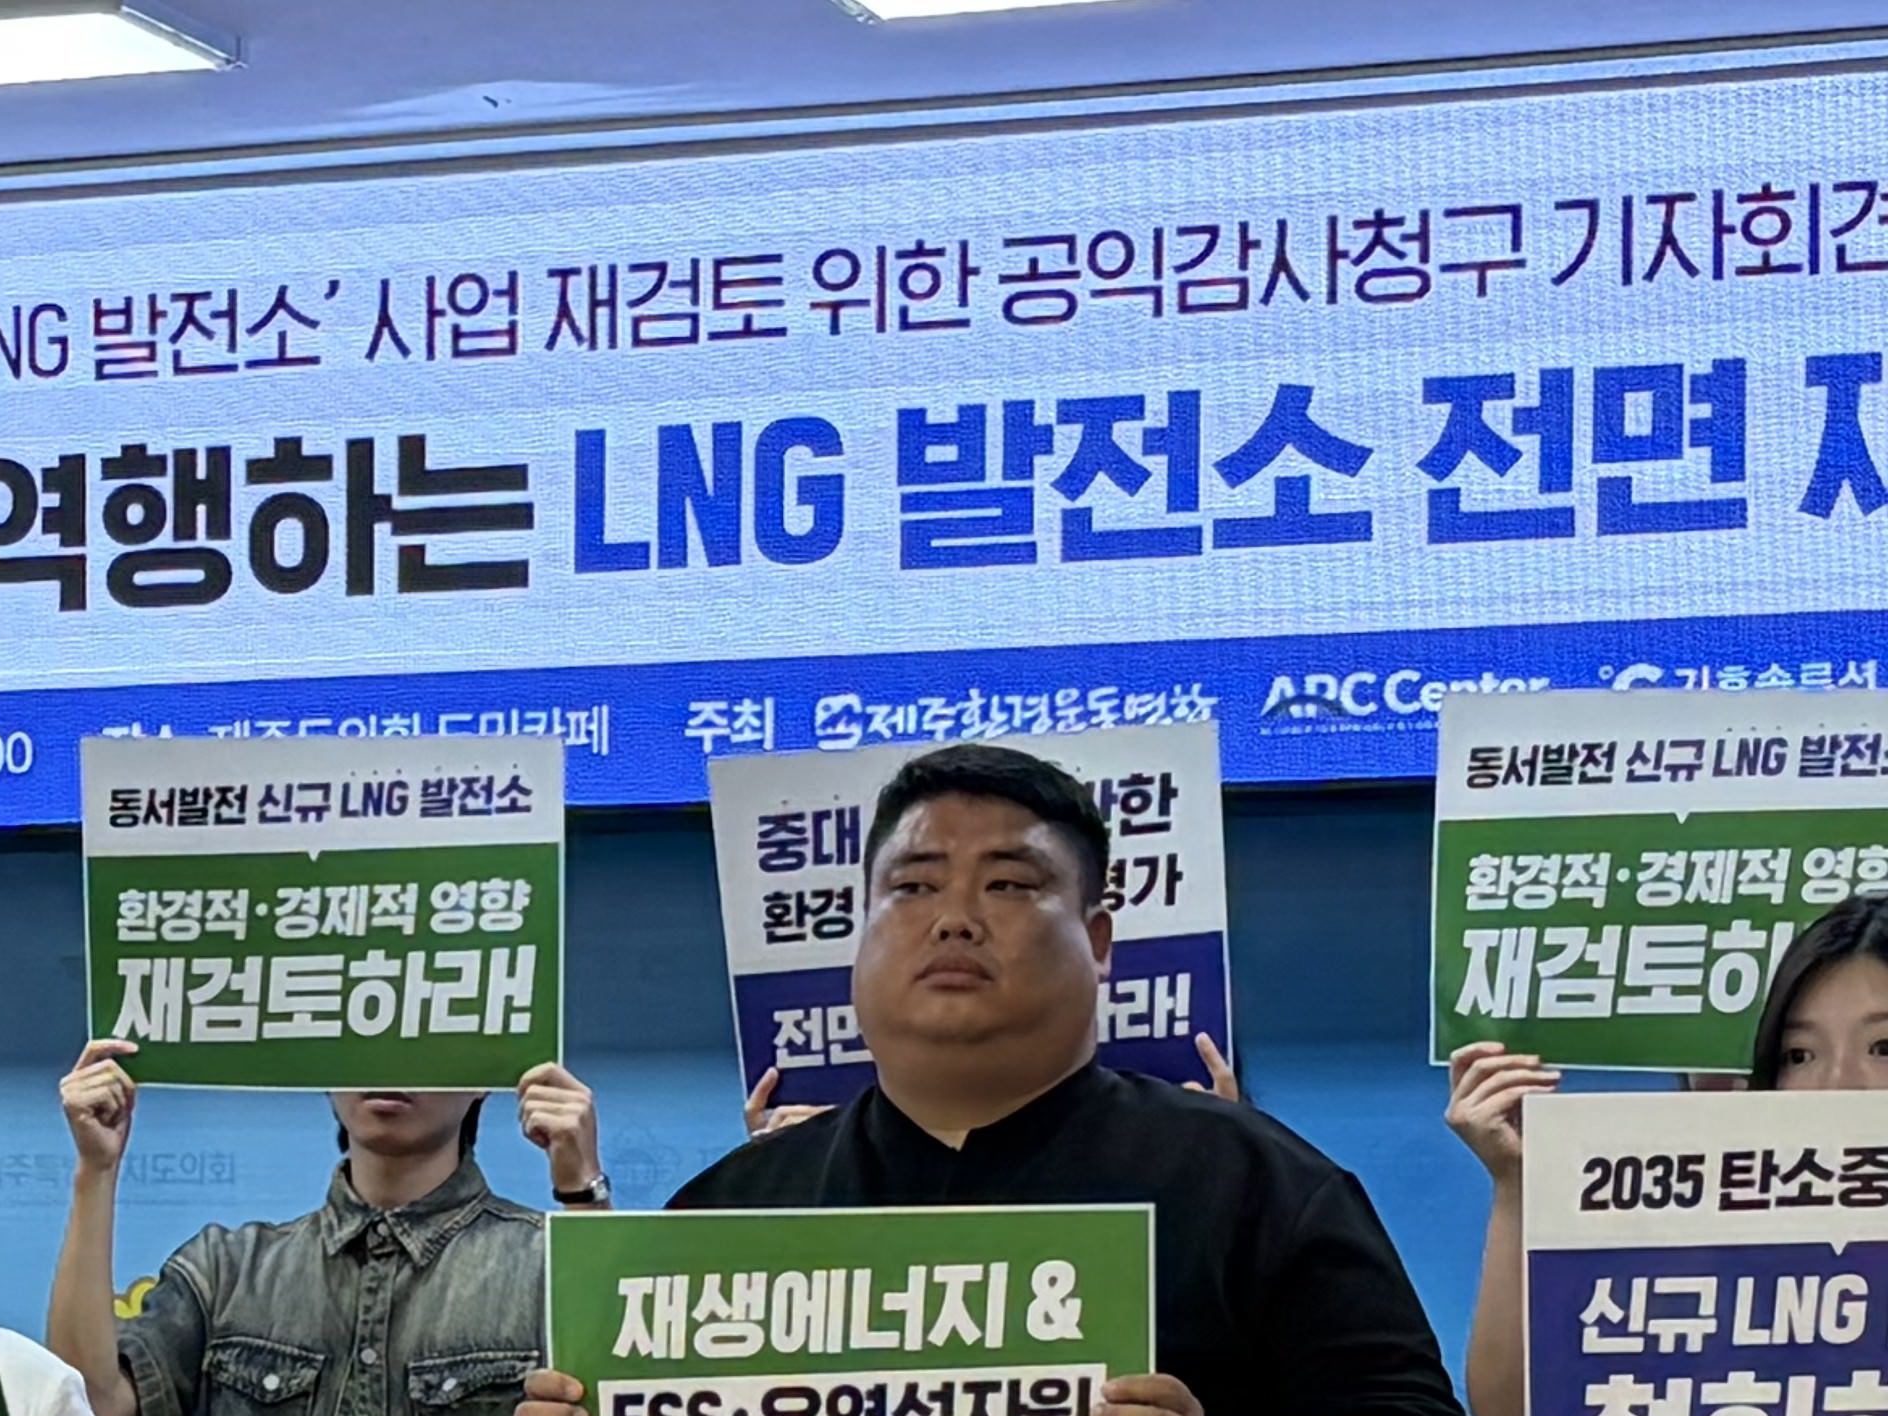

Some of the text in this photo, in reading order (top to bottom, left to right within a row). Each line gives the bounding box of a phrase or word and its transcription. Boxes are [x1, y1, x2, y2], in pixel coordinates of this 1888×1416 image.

[365, 271, 519, 362] 사업
[545, 253, 789, 354] 재검토
[812, 240, 980, 338] 위한
[998, 204, 1526, 326] 공익감사청구
[574, 417, 845, 574] LNG
[896, 383, 1373, 570] 발전소
[1418, 357, 1747, 544] 전면
[685, 698, 775, 753] 주최
[1466, 733, 1888, 790] 동서발전 신규 LNG 발전
[108, 774, 533, 828] 동서발전 신규 LNG 발전소
[757, 805, 860, 873] 중대
[116, 878, 531, 941] 환경적·경제적 영향
[1465, 847, 1792, 911] 환경적·경제적
[111, 945, 537, 1043] 재검토하라!
[1580, 1154, 1706, 1212] 2035
[612, 1260, 1083, 1359] 재생에너지 &
[1580, 1273, 1869, 1354] 신규 LNG
